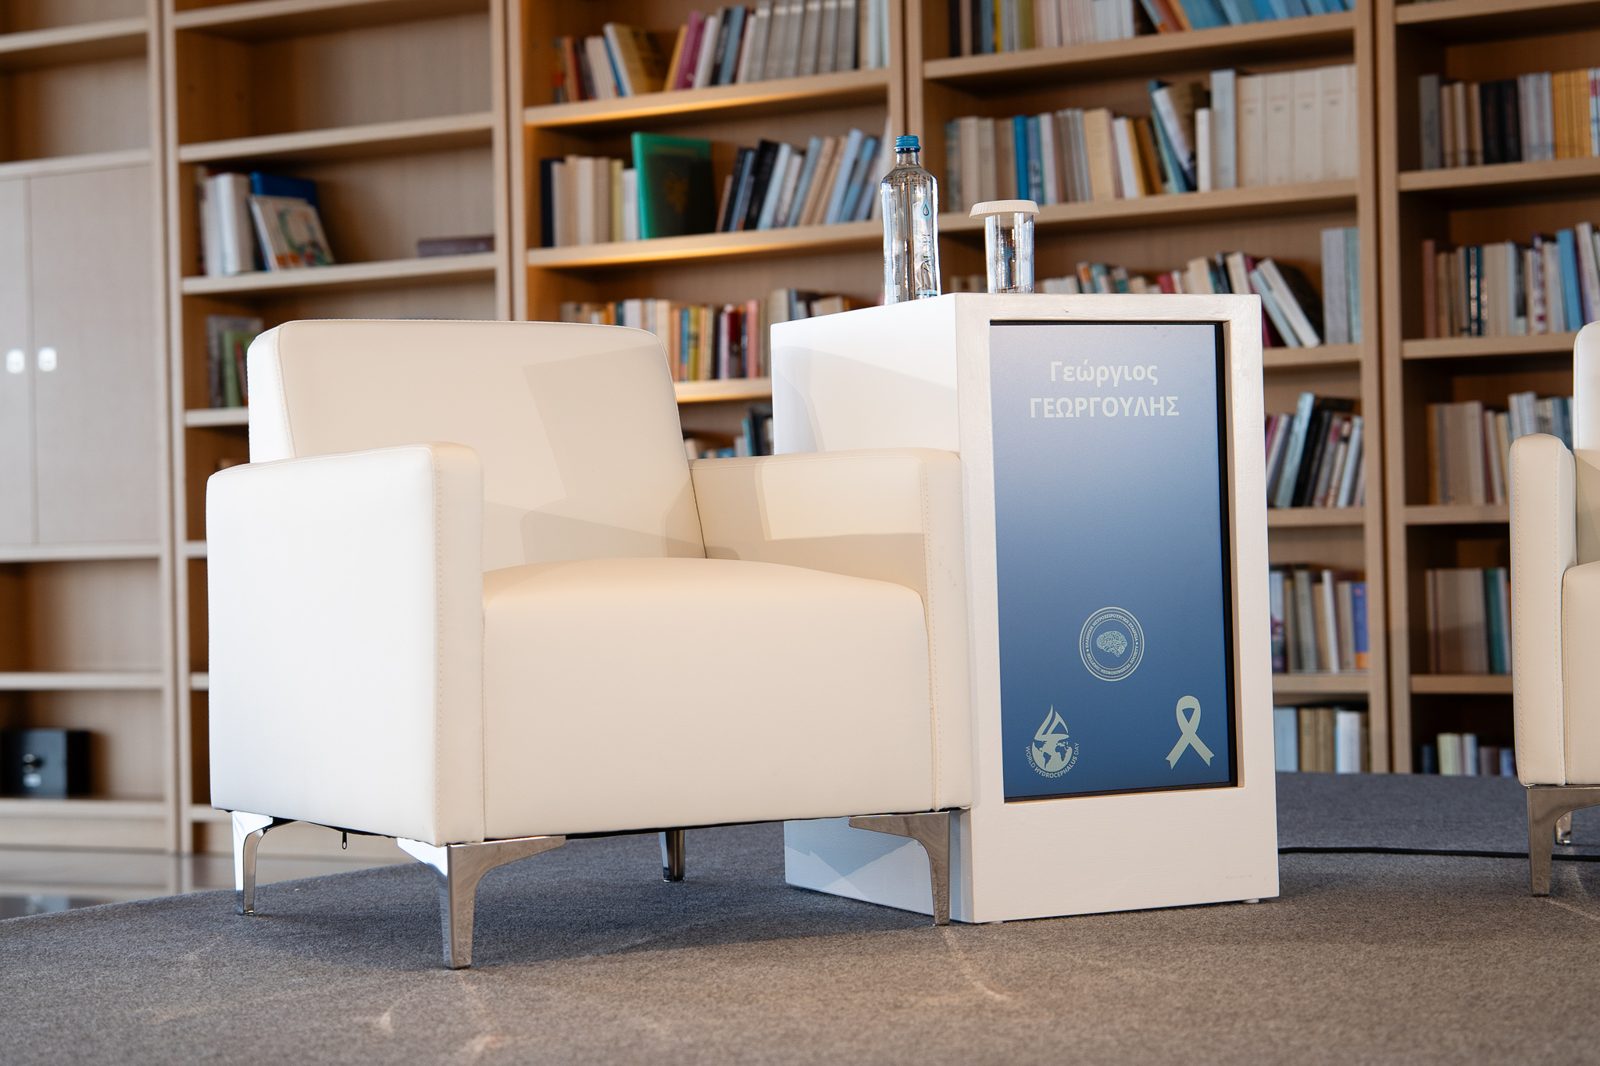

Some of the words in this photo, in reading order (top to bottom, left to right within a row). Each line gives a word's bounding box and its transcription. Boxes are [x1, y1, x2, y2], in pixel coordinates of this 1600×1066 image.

[1050, 359, 1159, 388] Γεώργιος
[1030, 396, 1180, 418] ΓΕΩΡΓΟΥΛΗΣ
[1025, 745, 1036, 768] WORLD
[1034, 756, 1078, 779] HYDROCEPHALUS
